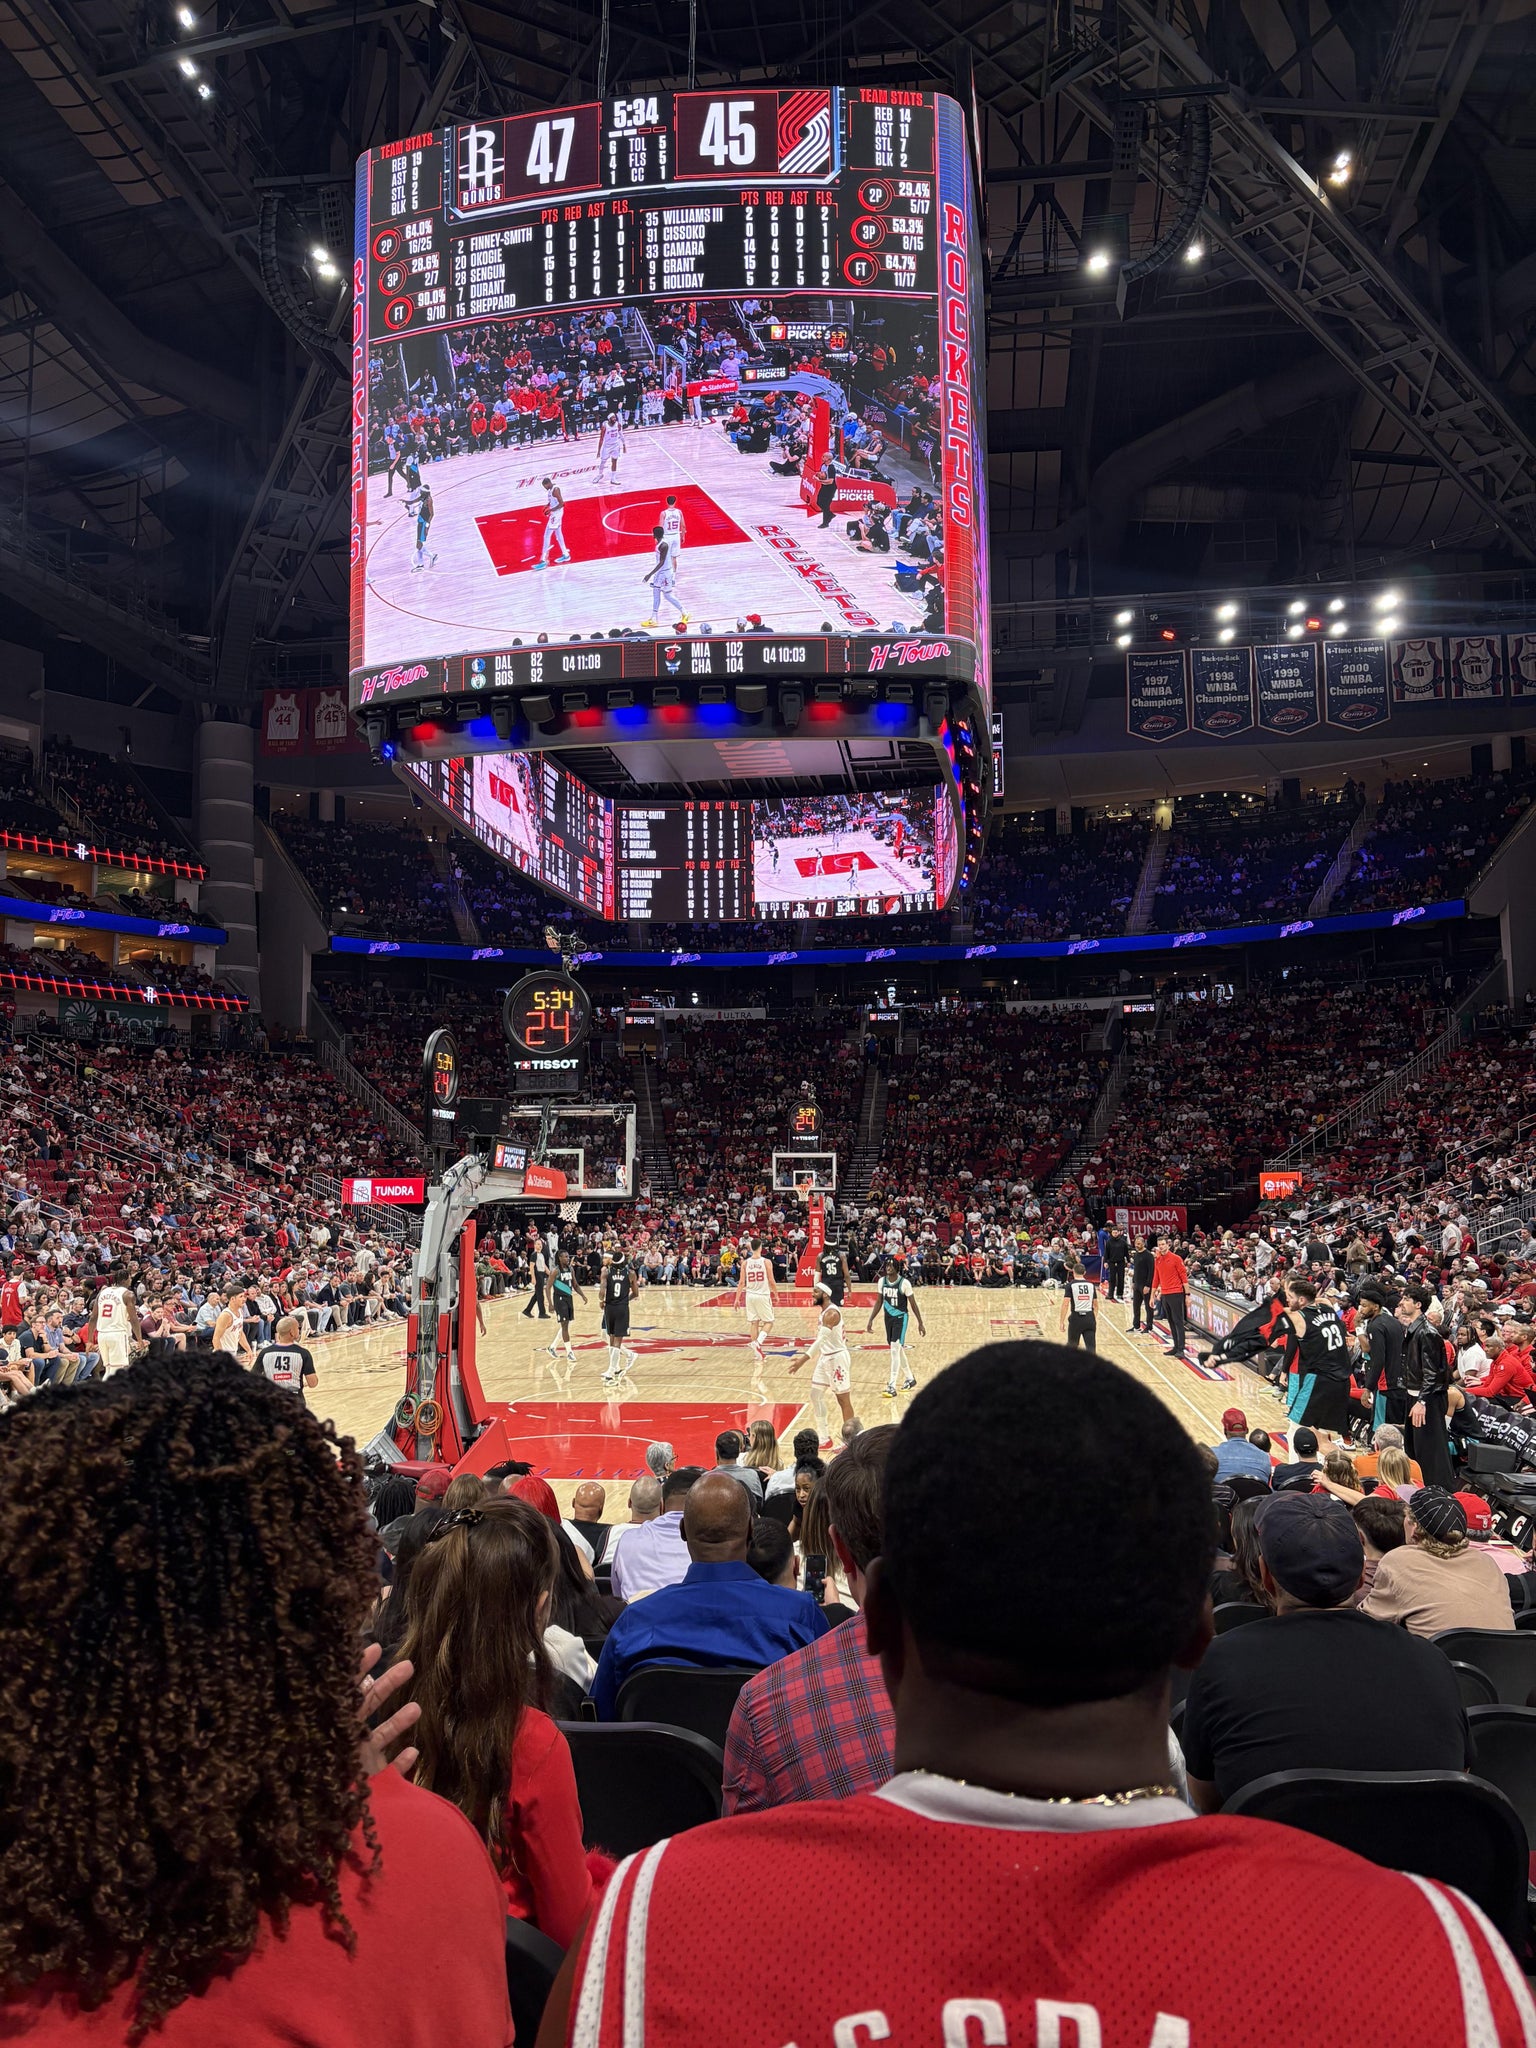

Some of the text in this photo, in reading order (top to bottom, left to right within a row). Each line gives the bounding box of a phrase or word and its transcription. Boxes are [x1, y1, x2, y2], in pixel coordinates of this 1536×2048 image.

[860, 90, 922, 106] TEAM STATS
[614, 98, 659, 128] 5:34
[875, 107, 911, 123] REB 14
[700, 101, 755, 165] 45
[875, 123, 909, 138] AST 11
[381, 133, 433, 159] TEAM STATS
[526, 117, 574, 184] 47
[610, 136, 666, 154] 6 TOL 5
[875, 138, 906, 152] STL 7
[392, 152, 422, 172] REB 19
[609, 150, 666, 170] 4 FLS 5
[875, 153, 907, 167] BLK 2
[392, 166, 418, 186] AST 9
[392, 181, 418, 201] STL 2
[463, 186, 501, 206] BONUS
[741, 191, 832, 205] PTS REB AST FLS
[870, 182, 929, 201] 2P 29.4%
[392, 195, 418, 216] BLK 5
[910, 199, 929, 214] 5/17
[646, 207, 722, 225] 35 WILLIAMS III
[647, 225, 705, 242] 91 CISSOKO
[863, 219, 923, 239] 3P 53.3%
[381, 222, 432, 253] 2P 64.0%
[458, 228, 532, 253] 2 FINNEY-SMITH
[903, 236, 923, 250] 8/15
[409, 238, 432, 255] 16/25
[646, 240, 704, 258] 33 CAMARA
[455, 249, 502, 270] 20 OKOGIE
[649, 258, 695, 274] 9 GRANT
[855, 256, 915, 275] FT 64.7%
[387, 254, 439, 286] 3P 28.6%
[455, 265, 505, 285] 28 SENGUN
[425, 271, 439, 285] 2/7
[649, 274, 704, 290] 5 HOLIDAY
[894, 272, 915, 286] 11/17
[458, 280, 504, 301] 7 DURANT
[395, 290, 445, 320] FT 90.0%
[427, 305, 445, 320] 9/10
[456, 294, 516, 316] 15 SHEPPARD
[943, 202, 972, 527] ROCKETS
[691, 642, 805, 664] MIA 102 Q4 10:03
[868, 639, 951, 672] H-Town
[1354, 645, 1383, 653] Champs
[495, 653, 600, 672] DAL 82 Q4 11:08
[691, 658, 743, 673] CHA 104
[1343, 664, 1369, 673] 2000
[1470, 665, 1482, 674] 14
[495, 669, 543, 686] BOS 92
[1209, 672, 1234, 681] 1998
[1274, 669, 1299, 678] 1999
[1340, 675, 1372, 684] WNBA
[1412, 667, 1424, 677] 10
[361, 664, 429, 704] H-Town
[1145, 676, 1168, 685] 1997
[1206, 683, 1237, 692] WNBA
[1271, 679, 1303, 689] WNBA
[1142, 687, 1172, 696] WNBA
[1196, 693, 1249, 704] Champions
[1261, 691, 1314, 701] Champions
[1330, 686, 1384, 697] Champions
[1132, 697, 1183, 708] Champions
[276, 713, 291, 725] 44
[324, 711, 339, 723] 45
[816, 902, 826, 917] 47
[838, 900, 855, 911] 5:34
[867, 899, 879, 914] 45
[534, 990, 573, 1010] 5:34
[526, 1011, 569, 1045] 24
[531, 1060, 579, 1069] TISSOT
[796, 1116, 814, 1130] 24
[375, 1186, 414, 1197] TUNDRA
[1130, 1210, 1179, 1222] TUNDRA
[748, 1271, 764, 1282] 28
[826, 1263, 837, 1275] 35
[614, 1282, 621, 1297] 9
[883, 1287, 899, 1299] PDX
[1078, 1285, 1089, 1294] 58
[102, 1304, 113, 1318] 2
[1321, 1324, 1344, 1351] 23
[275, 1356, 290, 1371] 43
